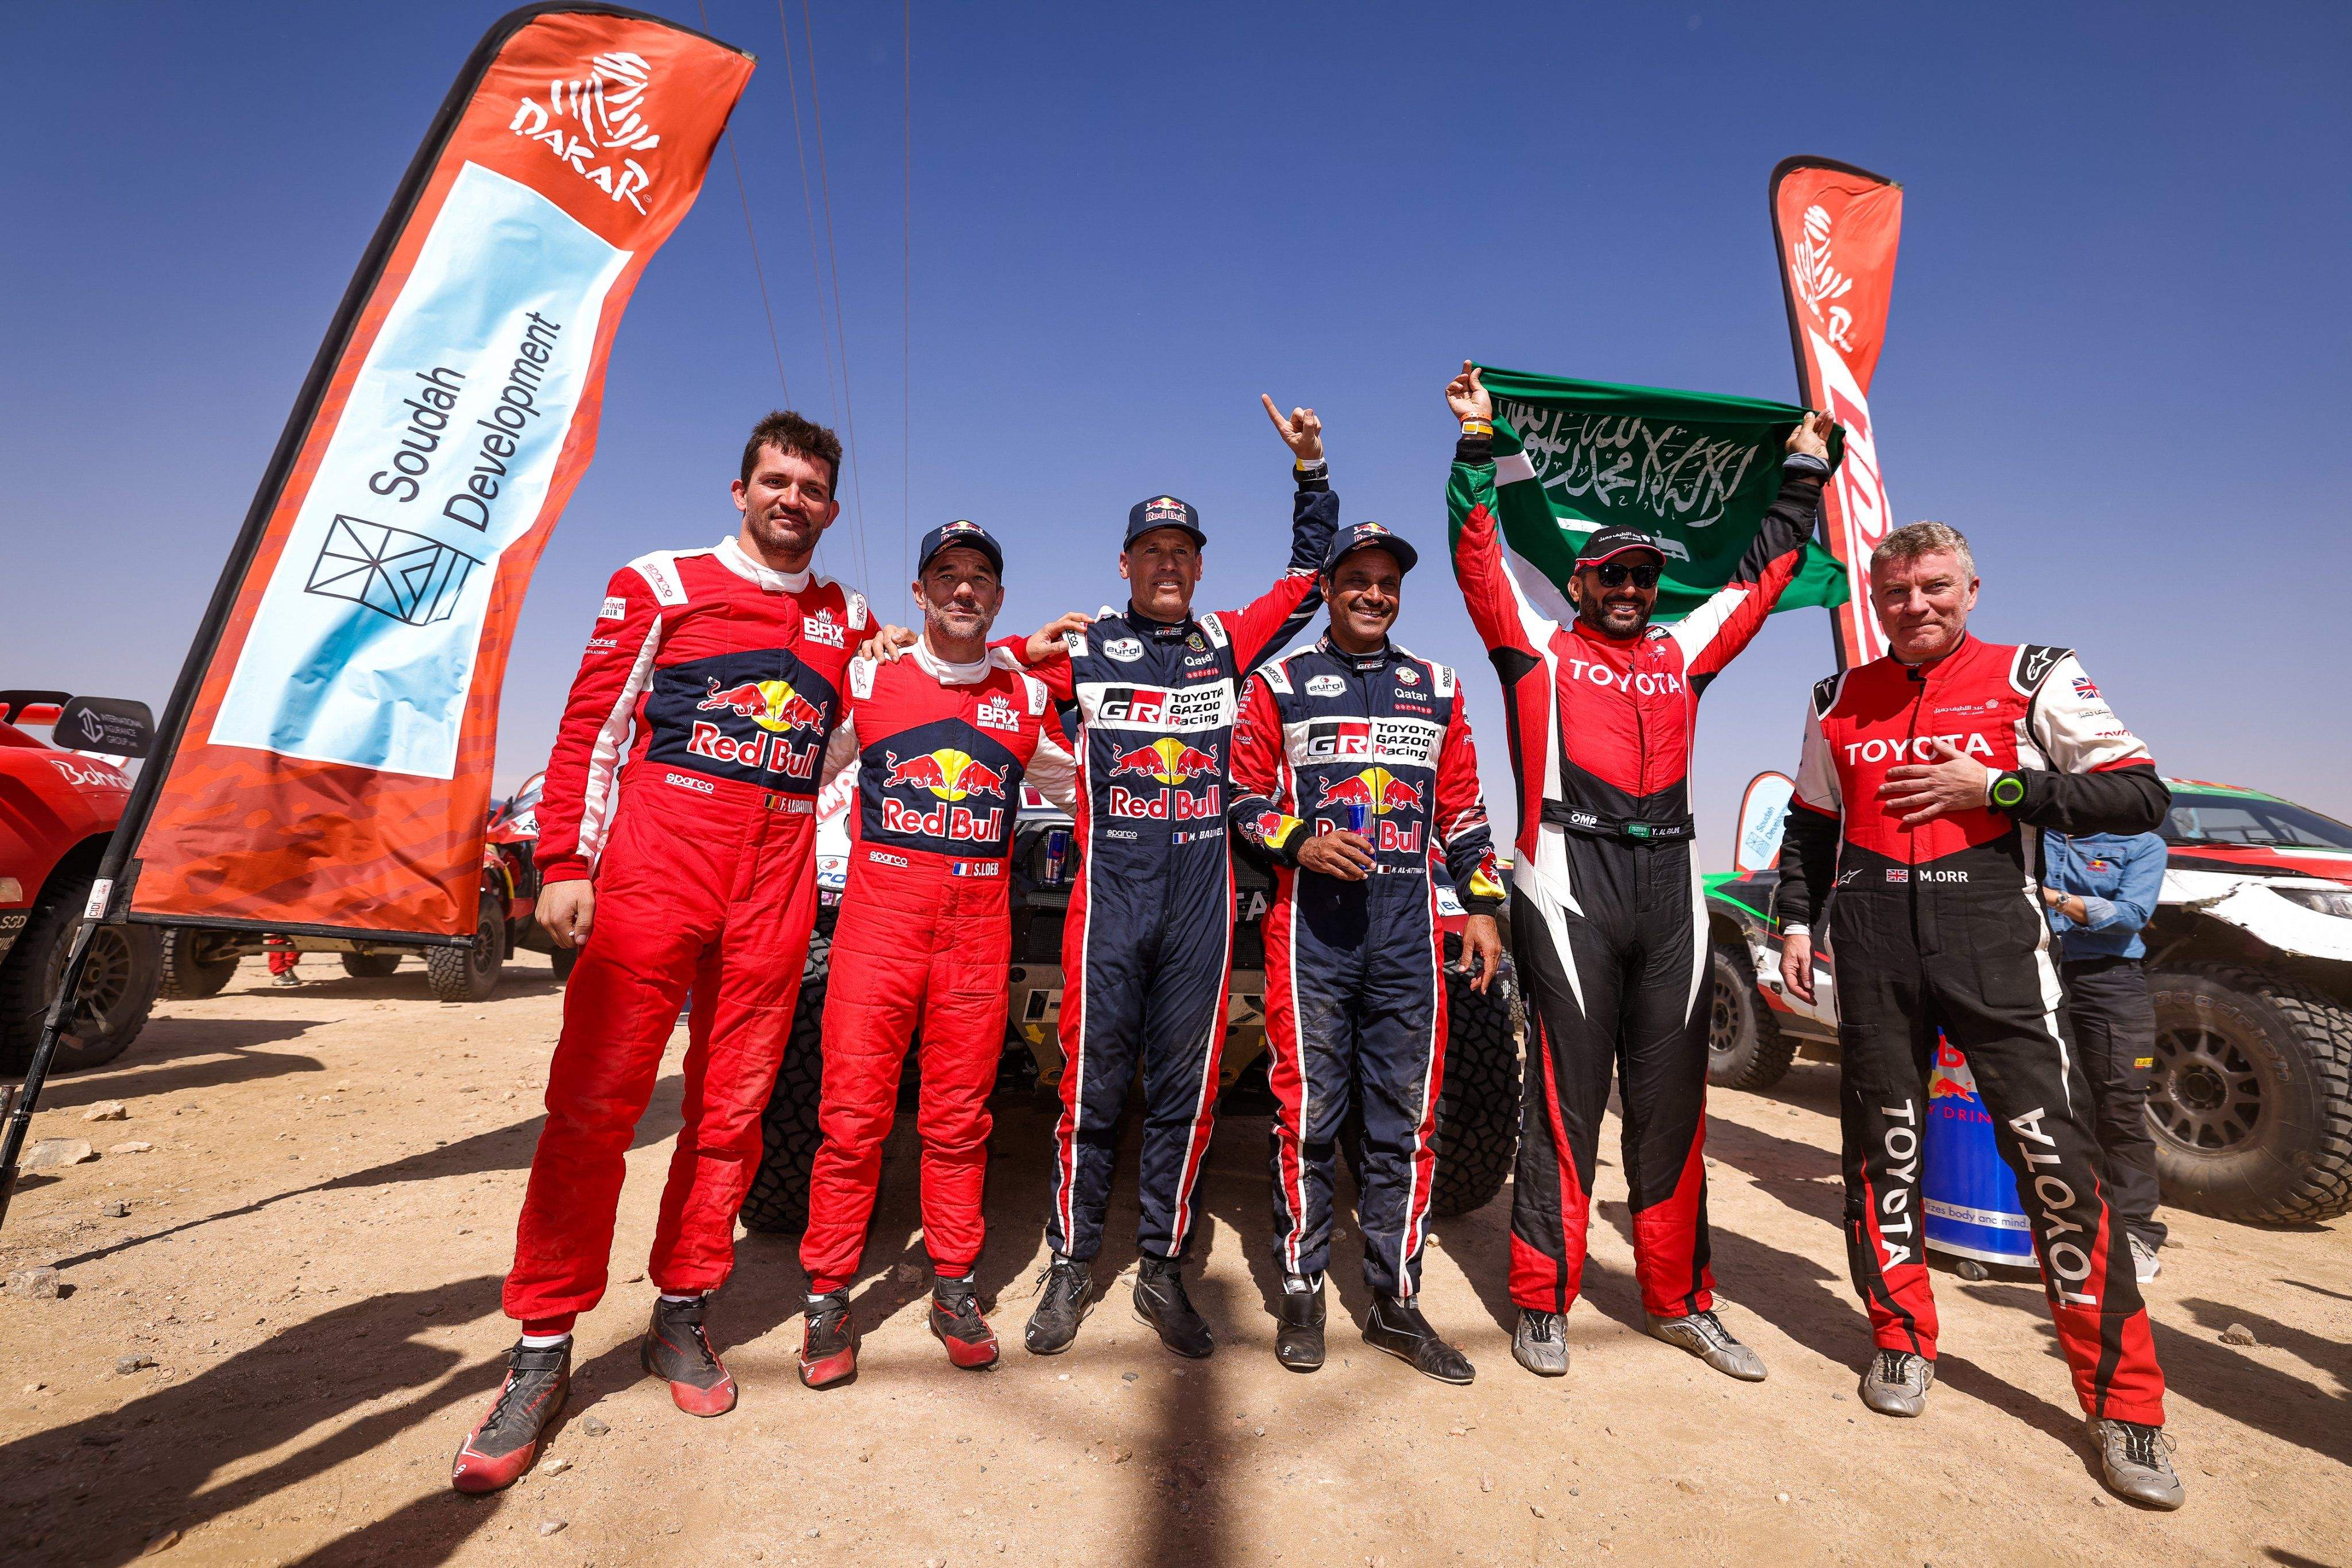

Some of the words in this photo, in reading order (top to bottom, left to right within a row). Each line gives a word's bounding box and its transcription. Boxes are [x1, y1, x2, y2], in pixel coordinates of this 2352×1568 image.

[509, 96, 649, 216] DAKAR
[443, 311, 562, 533] Development
[369, 366, 466, 503] Soudah
[1146, 509, 1167, 522] Red
[1167, 510, 1187, 524] Bull
[644, 564, 672, 598] sparco
[803, 617, 845, 643] BRX
[1107, 645, 1140, 655] eurol
[1185, 652, 1214, 667] Qatar
[1261, 665, 1283, 683] sparco
[1569, 658, 1683, 696] TOYOTA
[1310, 681, 1344, 691] eurol
[1394, 688, 1428, 701] Qatar
[1171, 687, 1224, 704] TOYOTA
[977, 703, 1021, 726] BRX
[1170, 701, 1221, 715] GAZOO
[100, 713, 145, 729] INTERNATIONAL
[1166, 713, 1219, 726] Racing
[1376, 723, 1436, 738] TOYOTA
[106, 735, 128, 745] GROUP
[1376, 734, 1430, 748] GAZOO
[686, 719, 769, 768] Red
[766, 736, 820, 780] Bull
[1375, 744, 1428, 761] Racing
[50, 760, 136, 791] Bahra
[664, 772, 714, 794] sparco
[1108, 785, 1170, 820] Red
[1175, 784, 1221, 821] Bull
[882, 797, 947, 838] Red
[948, 806, 1004, 842] Bull
[1570, 812, 1598, 827] OMP
[1757, 806, 1775, 833] Soudah
[1106, 828, 1138, 839] sparco
[1188, 833, 1197, 842] M.
[1379, 819, 1422, 853] Bull
[868, 850, 908, 868] sparco
[973, 862, 999, 877] S.LOEB
[1919, 870, 1969, 882] M.ORR
[89, 902, 102, 917] CIDI
[2150, 989, 2290, 1082] Goodrich
[1943, 1106, 1993, 1124] DRIN
[1880, 1098, 1918, 1274] TOYOTA
[1948, 1206, 1976, 1222] body
[2009, 1107, 2098, 1310] TOYOTA
